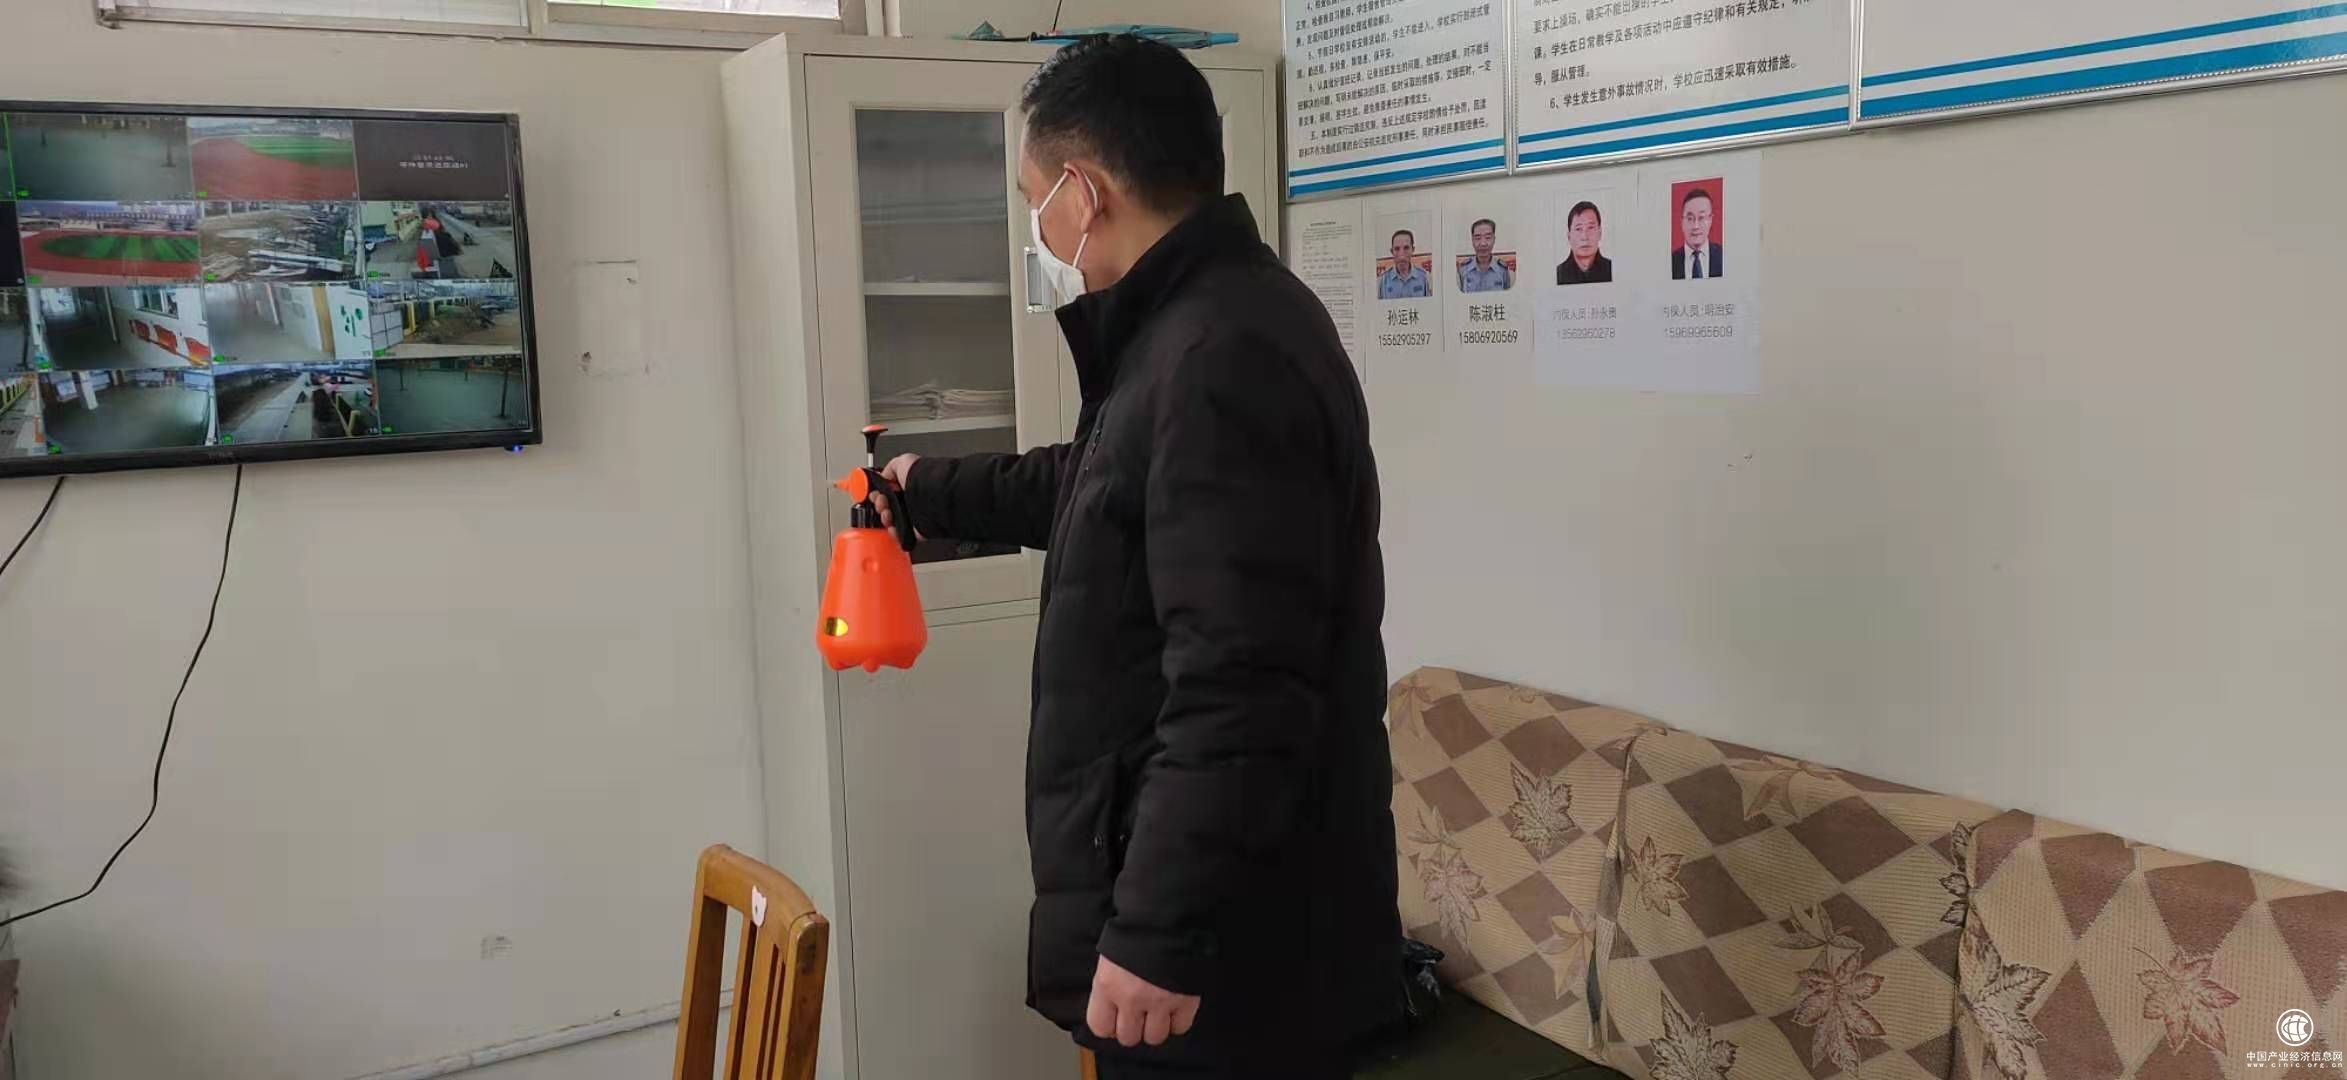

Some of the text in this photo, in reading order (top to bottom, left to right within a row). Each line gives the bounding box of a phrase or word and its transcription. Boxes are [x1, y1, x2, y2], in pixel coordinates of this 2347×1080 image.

[1388, 308, 1419, 326] 孙运林
[1469, 304, 1506, 322] 陈淑柱
[1378, 332, 1431, 347] 15562905297
[1459, 330, 1518, 344] 15806920569
